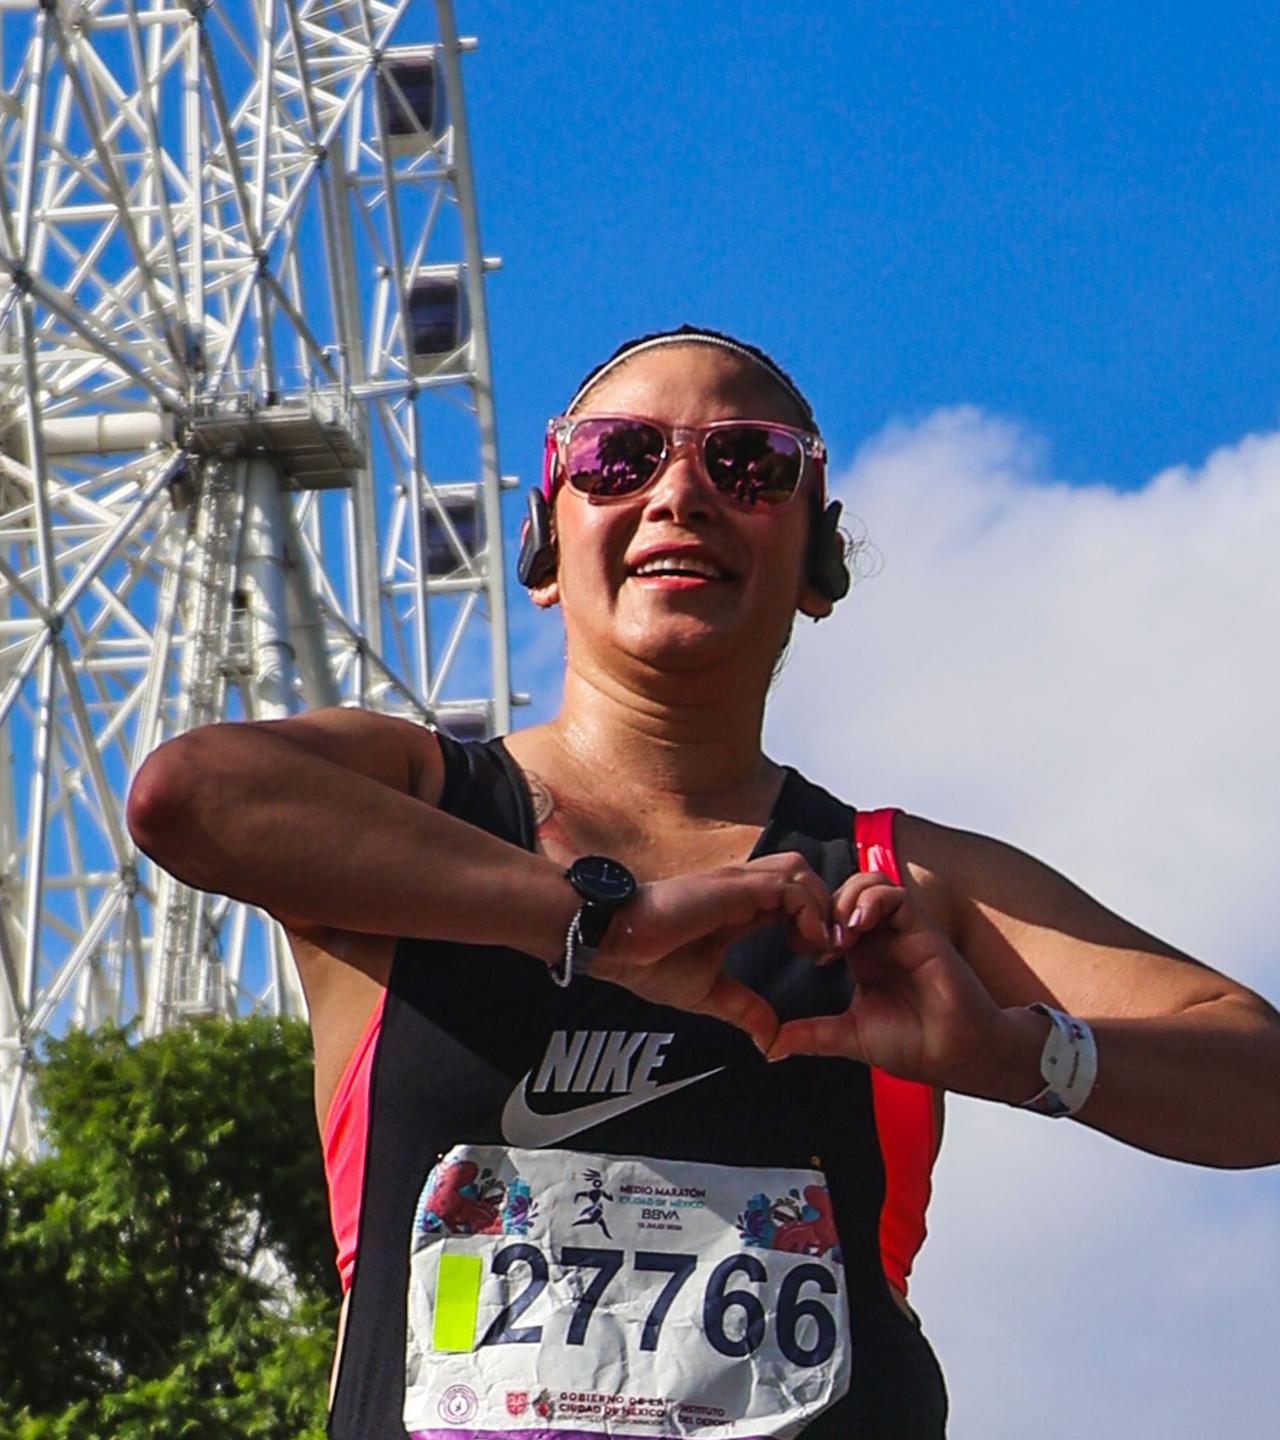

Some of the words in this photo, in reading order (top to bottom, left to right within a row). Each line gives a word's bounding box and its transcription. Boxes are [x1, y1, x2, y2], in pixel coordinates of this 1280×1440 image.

[532, 1030, 675, 1094] NIKE
[620, 1185, 652, 1196] MEDIO
[655, 1187, 706, 1198] MARATÓN
[619, 1196, 653, 1206] CIUDAD
[655, 1198, 667, 1207] DE
[641, 1208, 680, 1220] BBVA
[472, 1242, 838, 1368] 27766
[559, 1391, 625, 1405] GOBIERNO
[559, 1402, 601, 1414] CIUDAD
